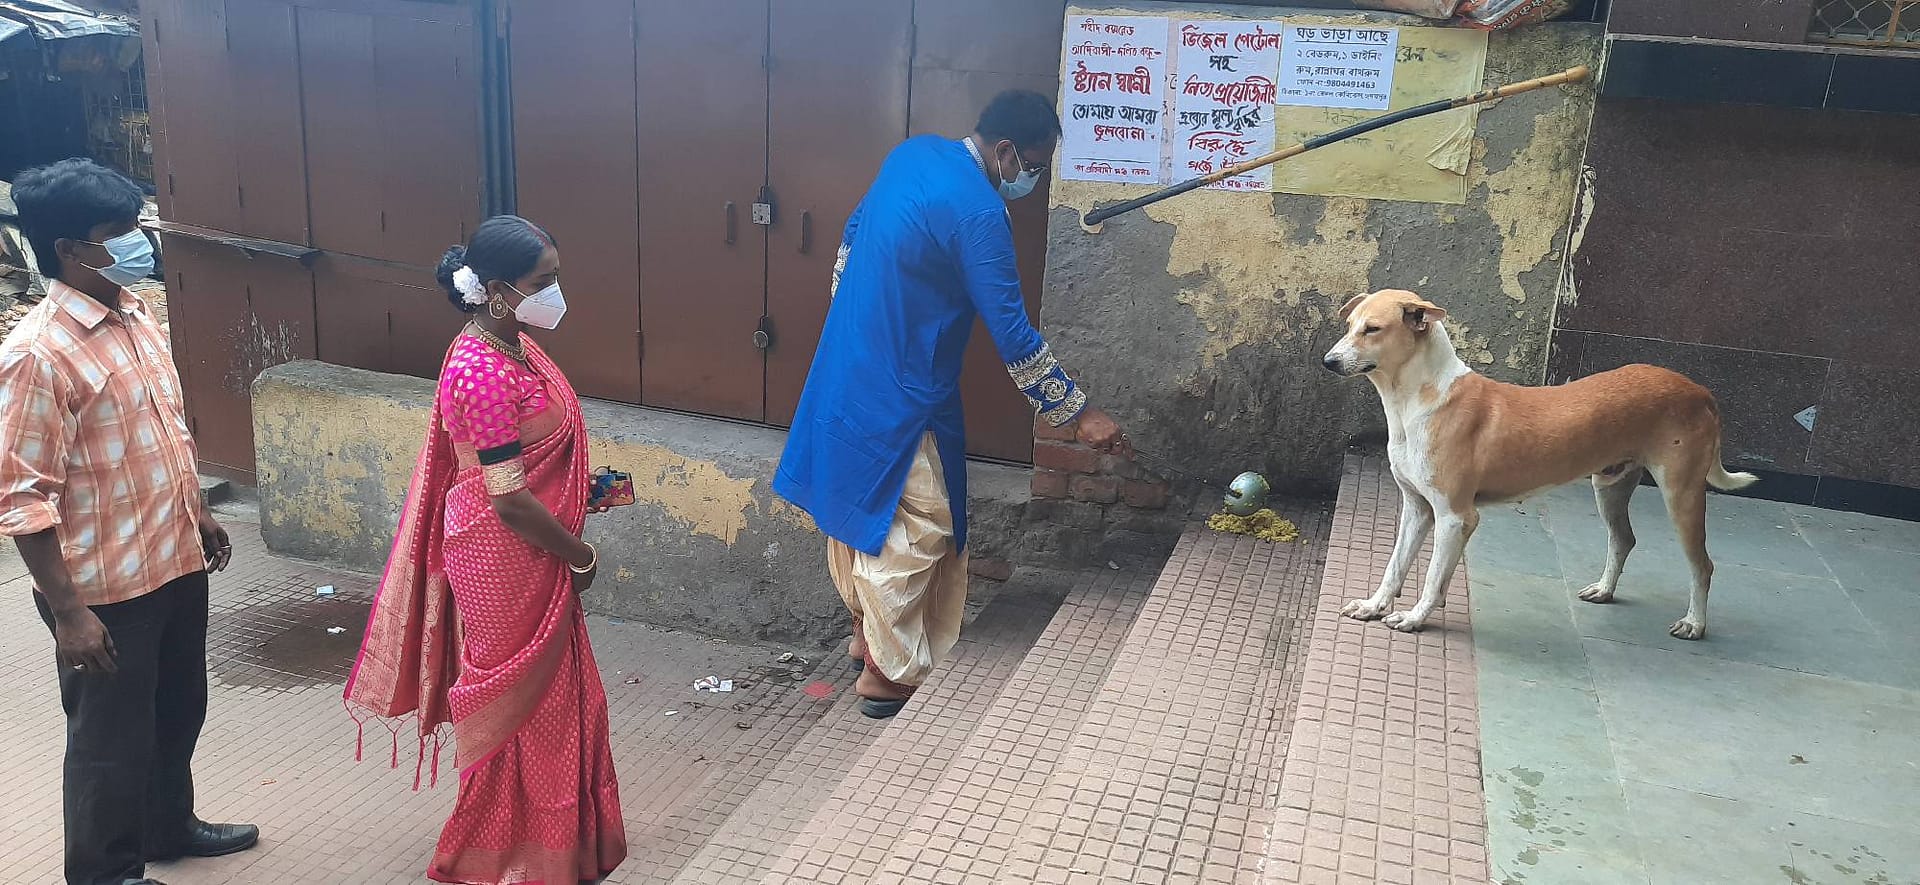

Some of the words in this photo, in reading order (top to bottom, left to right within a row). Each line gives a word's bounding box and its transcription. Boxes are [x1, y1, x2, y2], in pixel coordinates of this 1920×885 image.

[1182, 24, 1228, 53] ডিজেল
[1234, 24, 1281, 52] পেট্রোল
[1321, 28, 1352, 43] ভাড়া
[1356, 30, 1390, 43] আছে
[1296, 49, 1303, 58] ২
[1351, 50, 1383, 61] ডাইনিং
[1208, 55, 1239, 72] সহ
[1348, 68, 1381, 78] বাথরুম
[1118, 106, 1158, 124] আমরা
